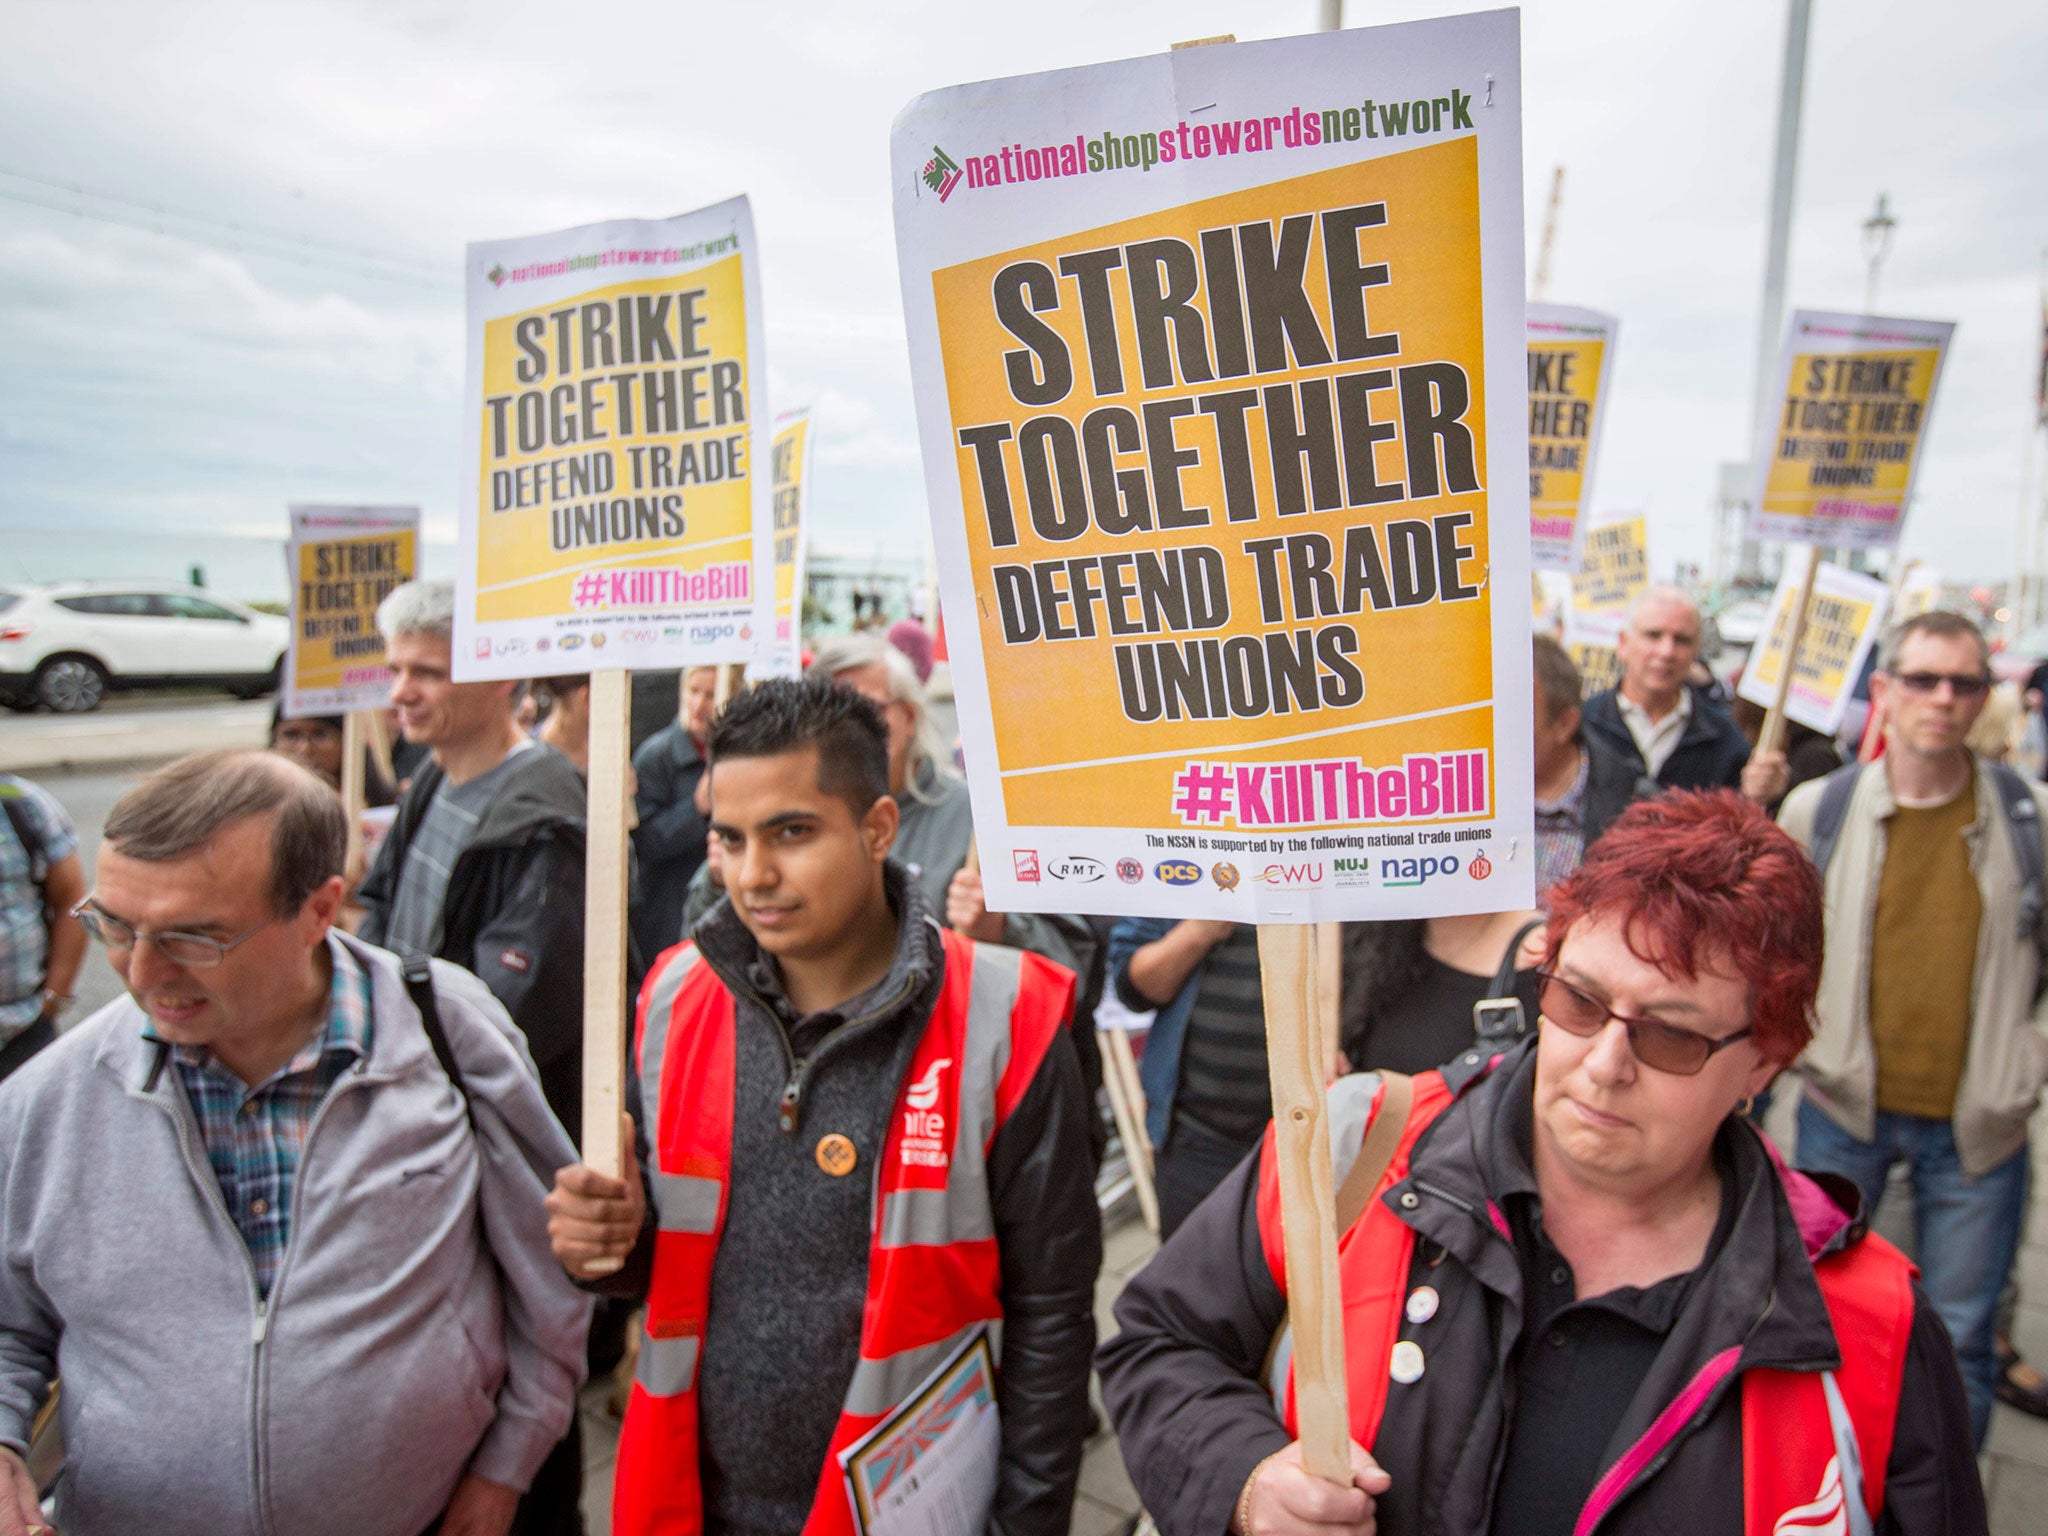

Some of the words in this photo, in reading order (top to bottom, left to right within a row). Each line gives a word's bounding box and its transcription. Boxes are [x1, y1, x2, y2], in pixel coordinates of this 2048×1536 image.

[965, 88, 1474, 190] nationalshopstewardsnetwork
[992, 201, 1402, 407] STRIKE
[515, 288, 712, 385] STRIKE
[1808, 357, 1915, 396] STRIKE
[486, 360, 747, 459] TOGETHER
[1786, 397, 1924, 433] TOGETHER
[492, 450, 614, 514] DEFEND
[627, 435, 746, 489] TRADE
[959, 360, 1486, 548] TOGETHER
[551, 494, 685, 552] UNIONS
[574, 564, 749, 607] #KillTheBill
[994, 545, 1233, 646] DEFEND
[1244, 511, 1481, 625] TRADE
[690, 624, 735, 642] napo
[1114, 624, 1367, 724] UNIONS
[1176, 751, 1486, 825] #KillTheBill
[1145, 833, 1164, 848] The
[1166, 834, 1196, 849] NSSN
[1199, 836, 1208, 850] is
[1211, 837, 1267, 854] supported
[1270, 838, 1284, 854] by
[1288, 838, 1308, 851] the
[1310, 833, 1365, 851] following
[1367, 832, 1416, 848] national
[1418, 830, 1452, 845] trade
[1454, 828, 1492, 843] unions
[1333, 857, 1369, 872] NUJ
[1060, 864, 1097, 876] RMT
[1159, 863, 1200, 884] pcs
[1263, 862, 1323, 884] CWU
[1381, 855, 1460, 885] napo
